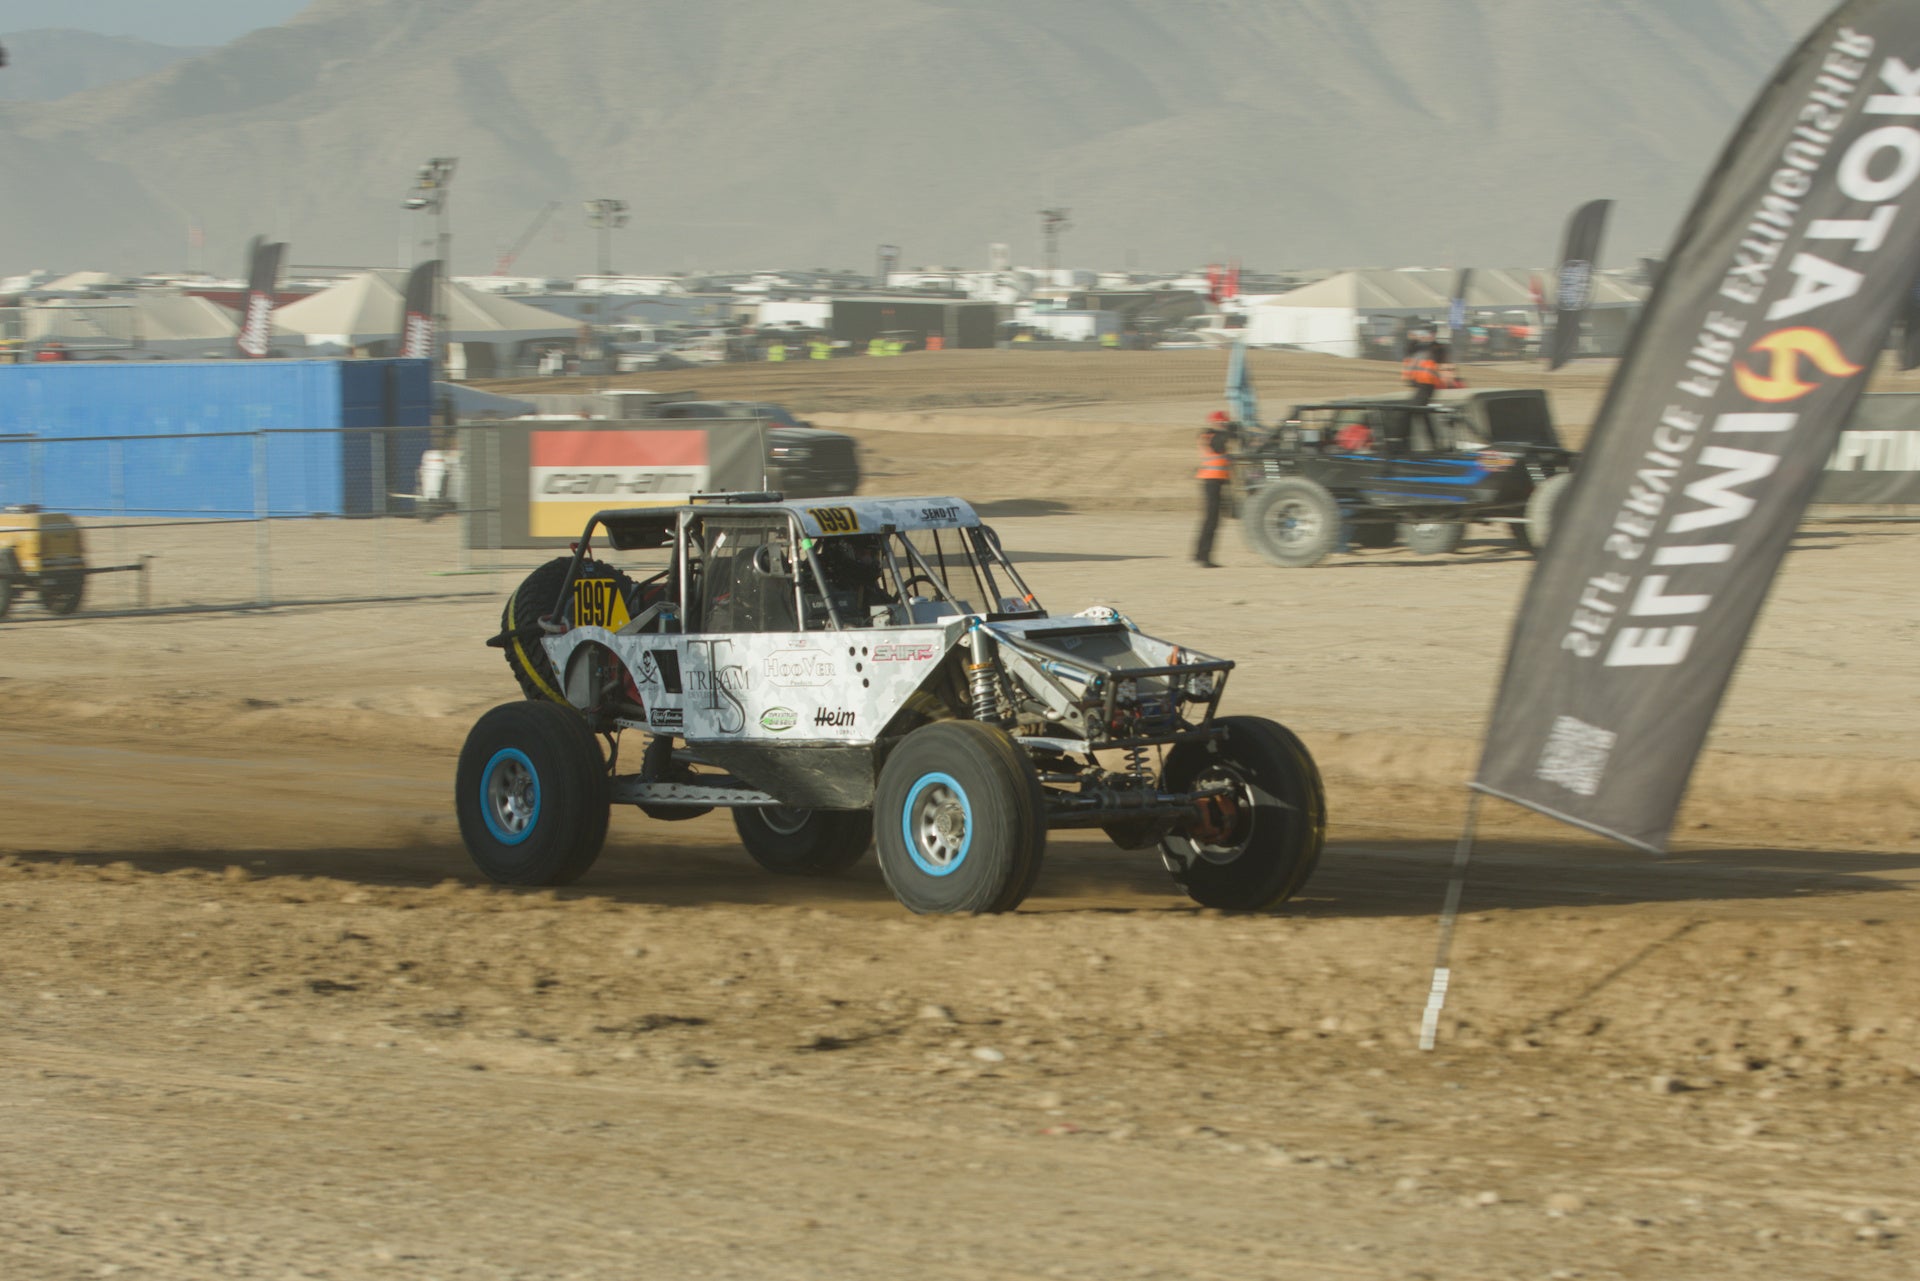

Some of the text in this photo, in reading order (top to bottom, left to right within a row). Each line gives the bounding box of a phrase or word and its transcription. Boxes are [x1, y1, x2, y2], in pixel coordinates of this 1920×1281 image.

[808, 507, 859, 533] 1997
[576, 580, 617, 627] 1997
[814, 707, 856, 727] Heim
